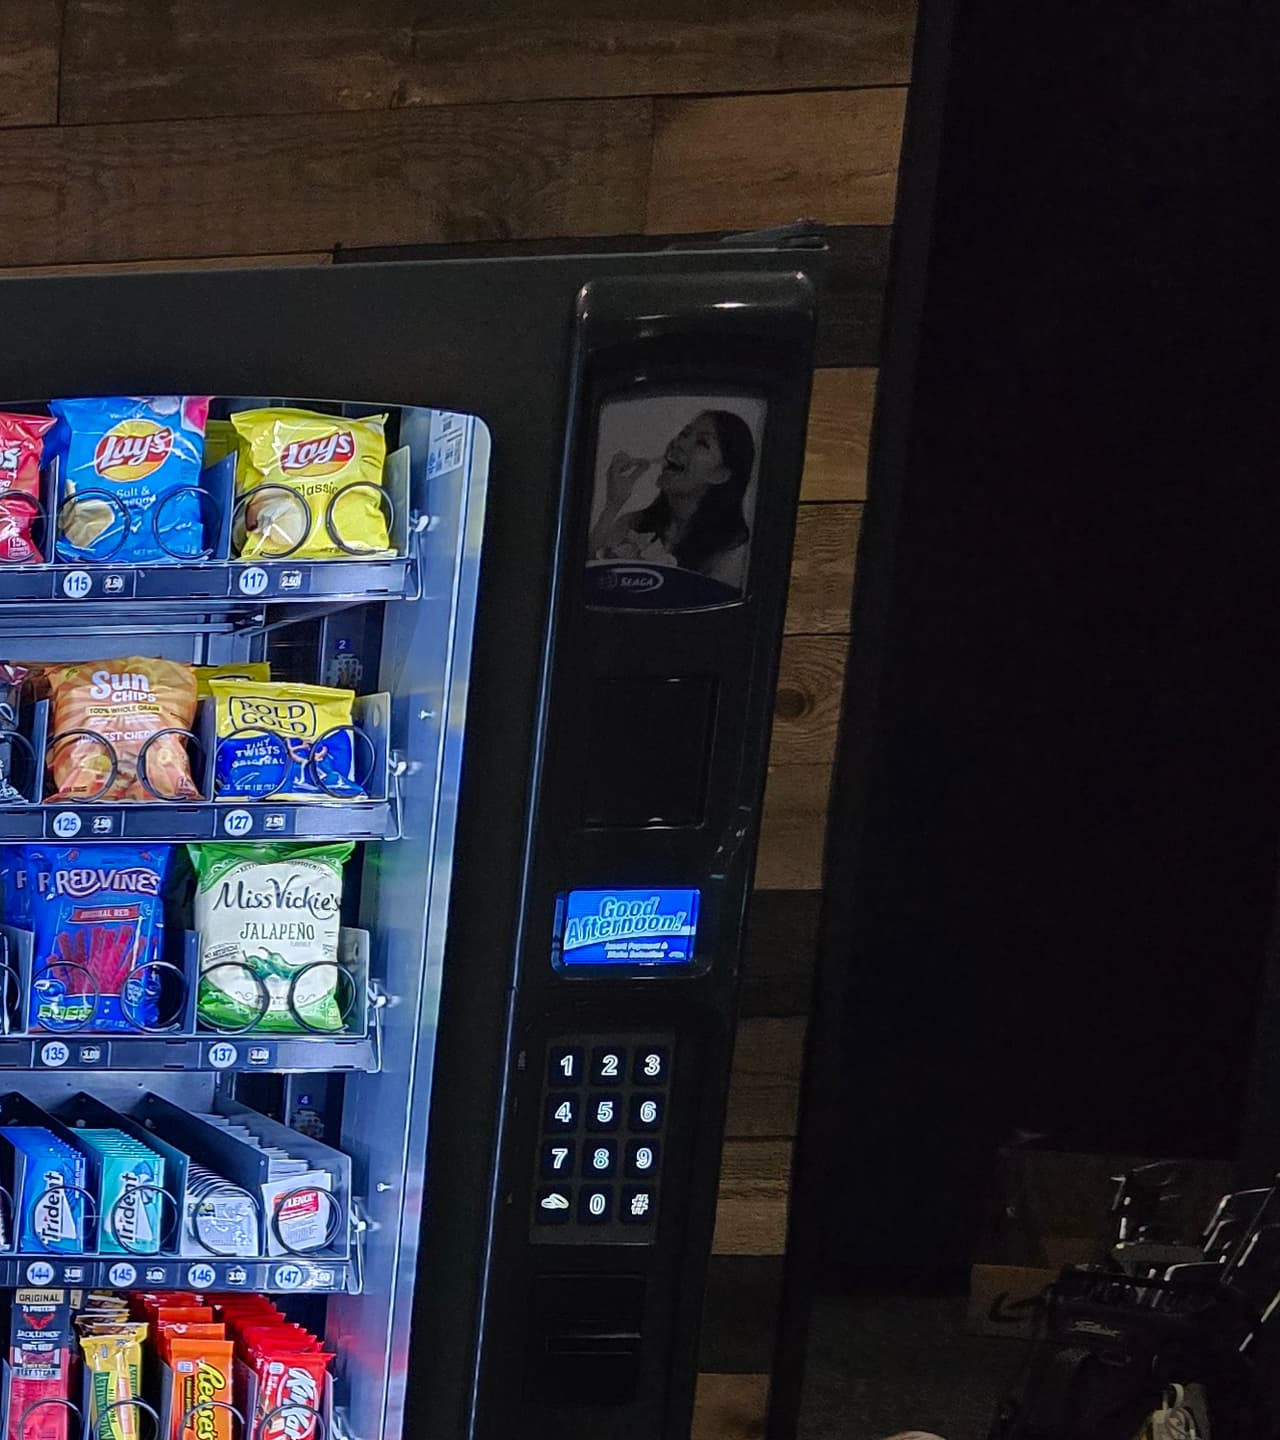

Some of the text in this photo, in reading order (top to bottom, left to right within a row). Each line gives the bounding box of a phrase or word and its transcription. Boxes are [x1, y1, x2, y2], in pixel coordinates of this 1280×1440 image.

[66, 577, 89, 591] 115
[241, 573, 265, 588] 117
[89, 669, 151, 700] Sun
[111, 690, 157, 703] CHIPS
[239, 700, 306, 719] ROLD
[241, 711, 308, 735] GOLD
[235, 746, 281, 758] TWISTS
[56, 817, 78, 832] 125
[227, 815, 250, 830] 127
[212, 874, 341, 921] Miss Vickie's
[600, 896, 661, 919] Good
[240, 921, 315, 941] JALAPEÑO
[566, 911, 688, 945] Afternoon!
[44, 1047, 67, 1062] 135
[211, 1047, 235, 1062] 137
[560, 1054, 574, 1077] 1
[600, 1054, 619, 1077] 2
[643, 1053, 661, 1077] 3
[554, 1101, 572, 1123] 4
[596, 1101, 614, 1123] 5
[639, 1100, 657, 1123] 6
[551, 1147, 569, 1169] 7
[592, 1147, 610, 1169] 8
[635, 1147, 653, 1169] 9
[40, 1169, 66, 1246] Trident
[117, 1171, 139, 1245] Trident
[589, 1193, 607, 1216] 0
[28, 1266, 52, 1281] 144
[112, 1267, 134, 1282] 145
[190, 1268, 213, 1284] 146
[278, 1269, 300, 1285] 147
[18, 1293, 61, 1303] ORIGINAL
